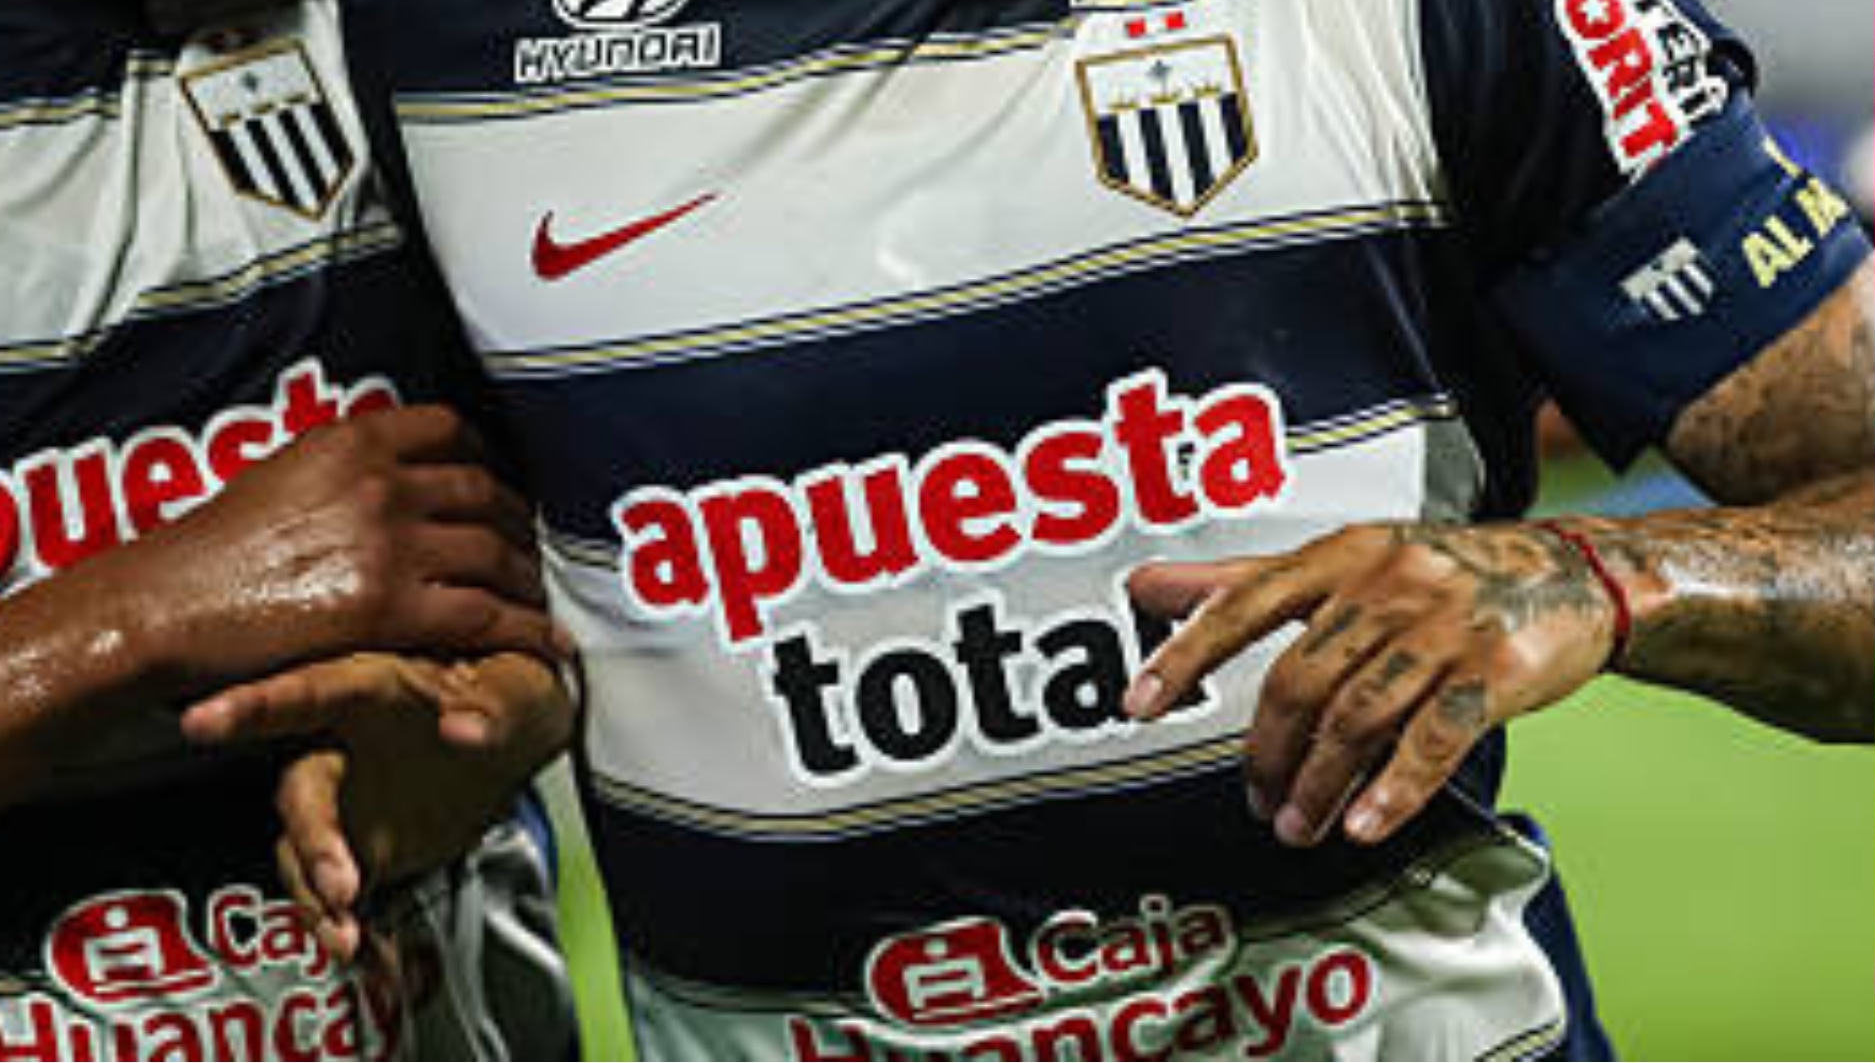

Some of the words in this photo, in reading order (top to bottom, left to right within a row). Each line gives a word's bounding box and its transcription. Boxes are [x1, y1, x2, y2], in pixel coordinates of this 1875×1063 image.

[514, 22, 721, 84] HYUNDAI
[1742, 215, 1814, 288] AL
[0, 368, 398, 572] ues
[618, 379, 1290, 642] apuesta
[211, 889, 331, 978] Caj
[1036, 895, 1231, 985] Caja
